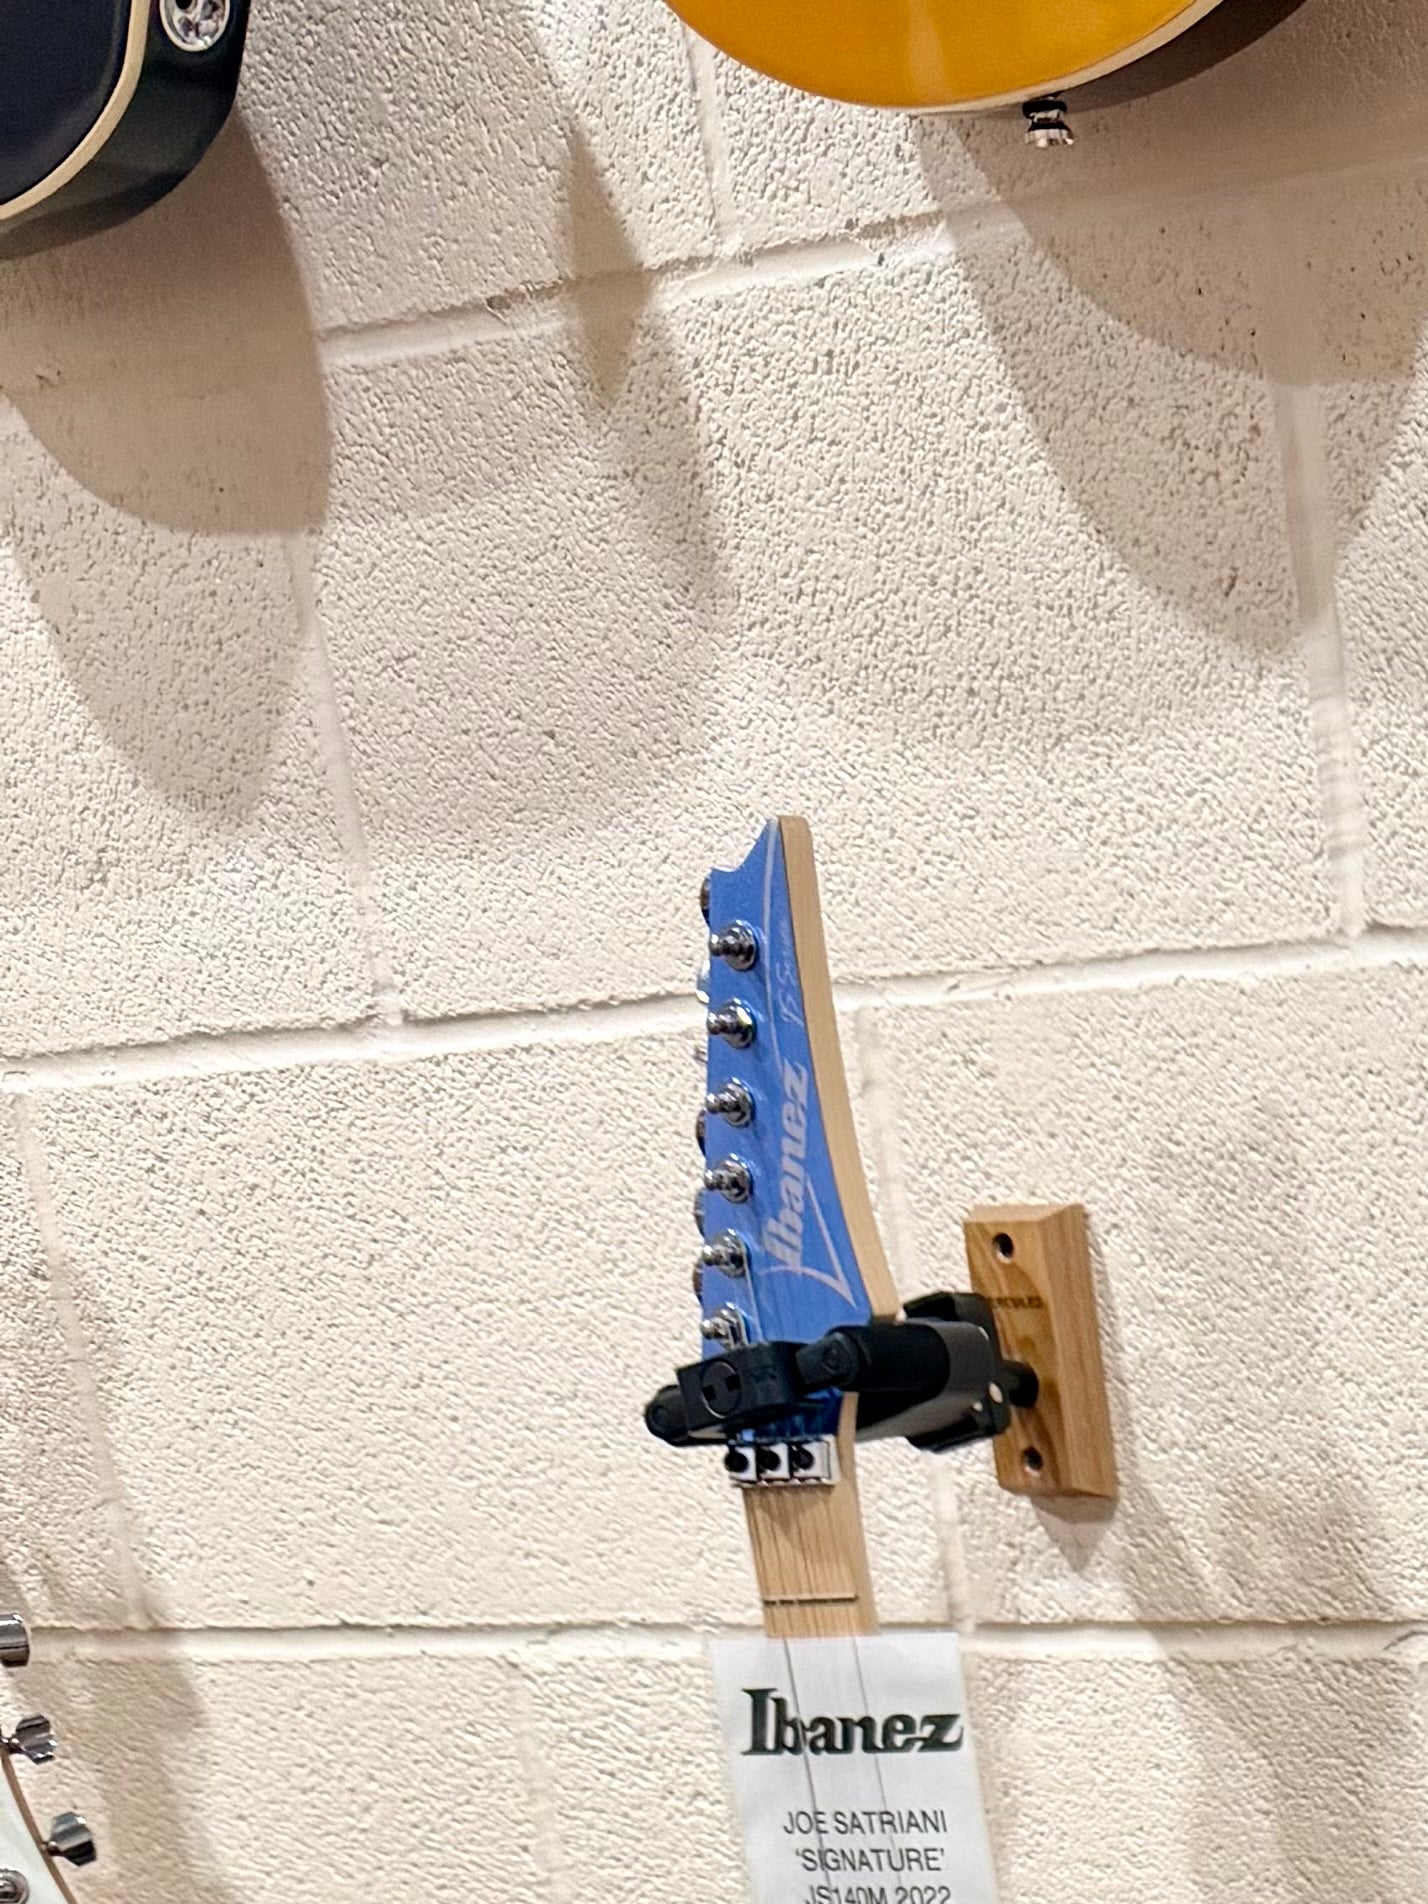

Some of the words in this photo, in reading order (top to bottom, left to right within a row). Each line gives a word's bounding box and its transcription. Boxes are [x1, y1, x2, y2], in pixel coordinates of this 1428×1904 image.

[762, 1058, 811, 1274] Ibanez
[740, 1686, 965, 1756] Ibanez
[783, 1810, 829, 1835] JOE
[833, 1809, 948, 1835] SATRIANI
